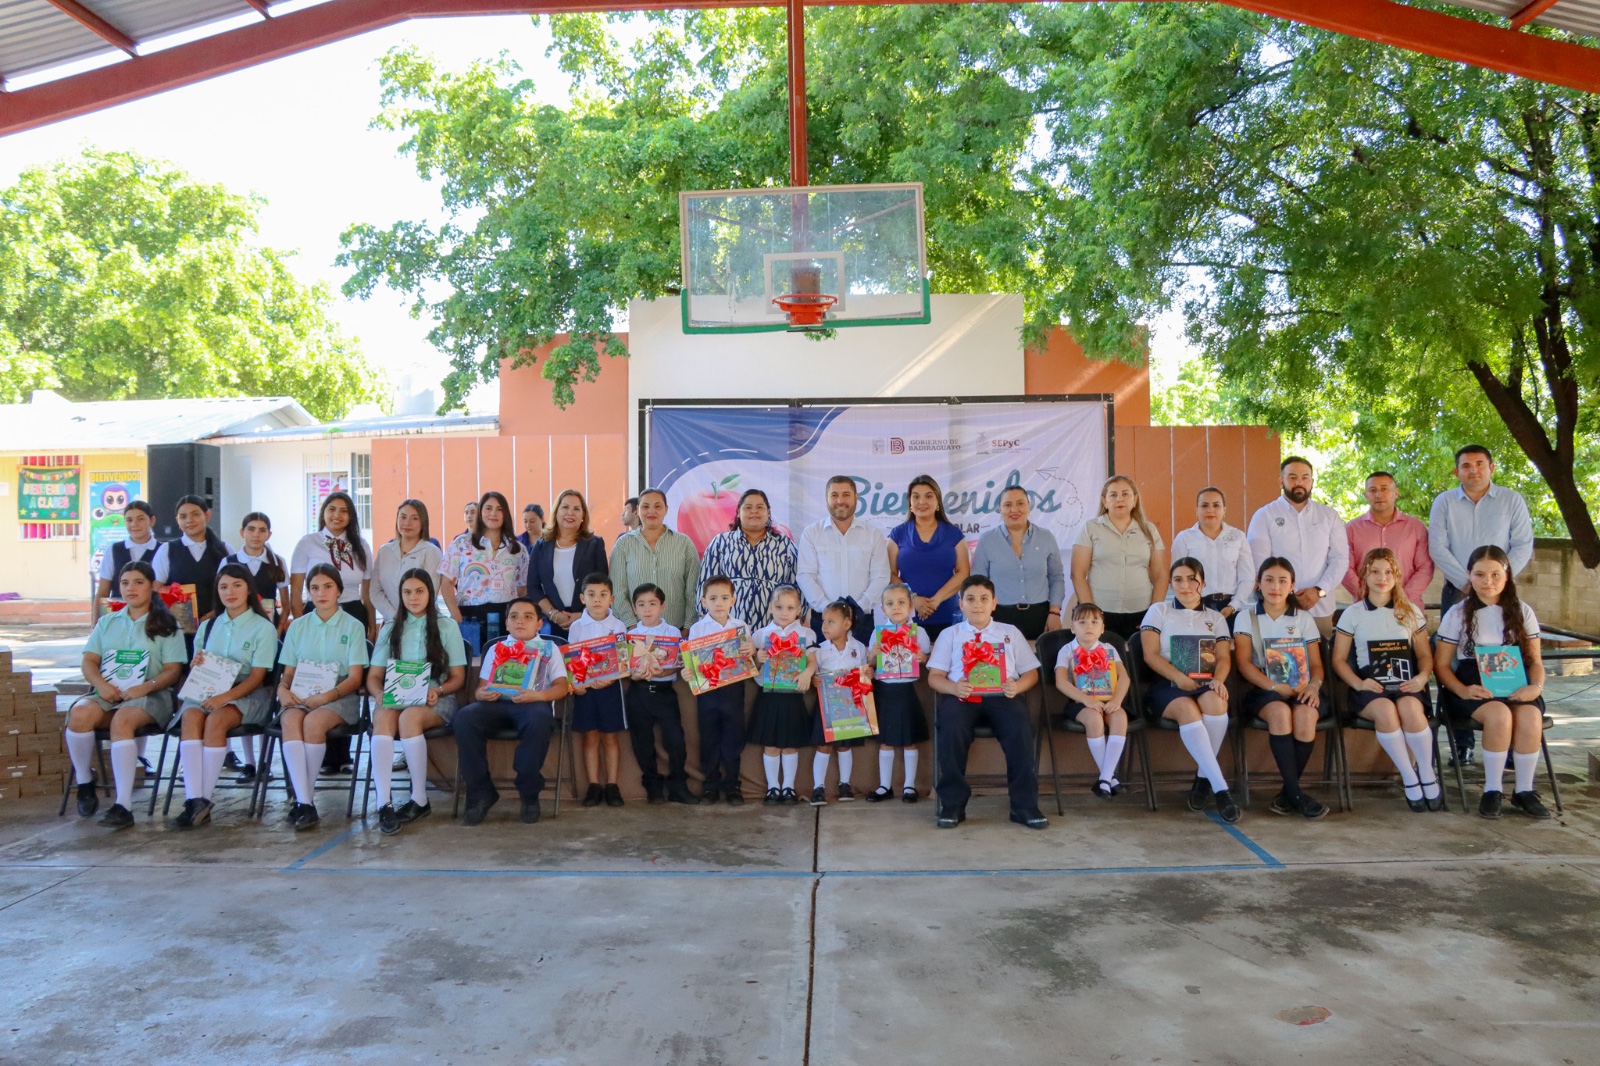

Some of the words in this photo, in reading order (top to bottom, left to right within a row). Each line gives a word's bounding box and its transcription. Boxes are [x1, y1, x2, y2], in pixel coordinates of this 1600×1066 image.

[991, 439, 1021, 448] SEPyC
[89, 472, 140, 483] BIENVENIDOS
[22, 483, 77, 495] BIENVENIDOS
[848, 469, 1062, 518] Bieenidos
[28, 496, 37, 509] A
[37, 496, 70, 509] CLASES
